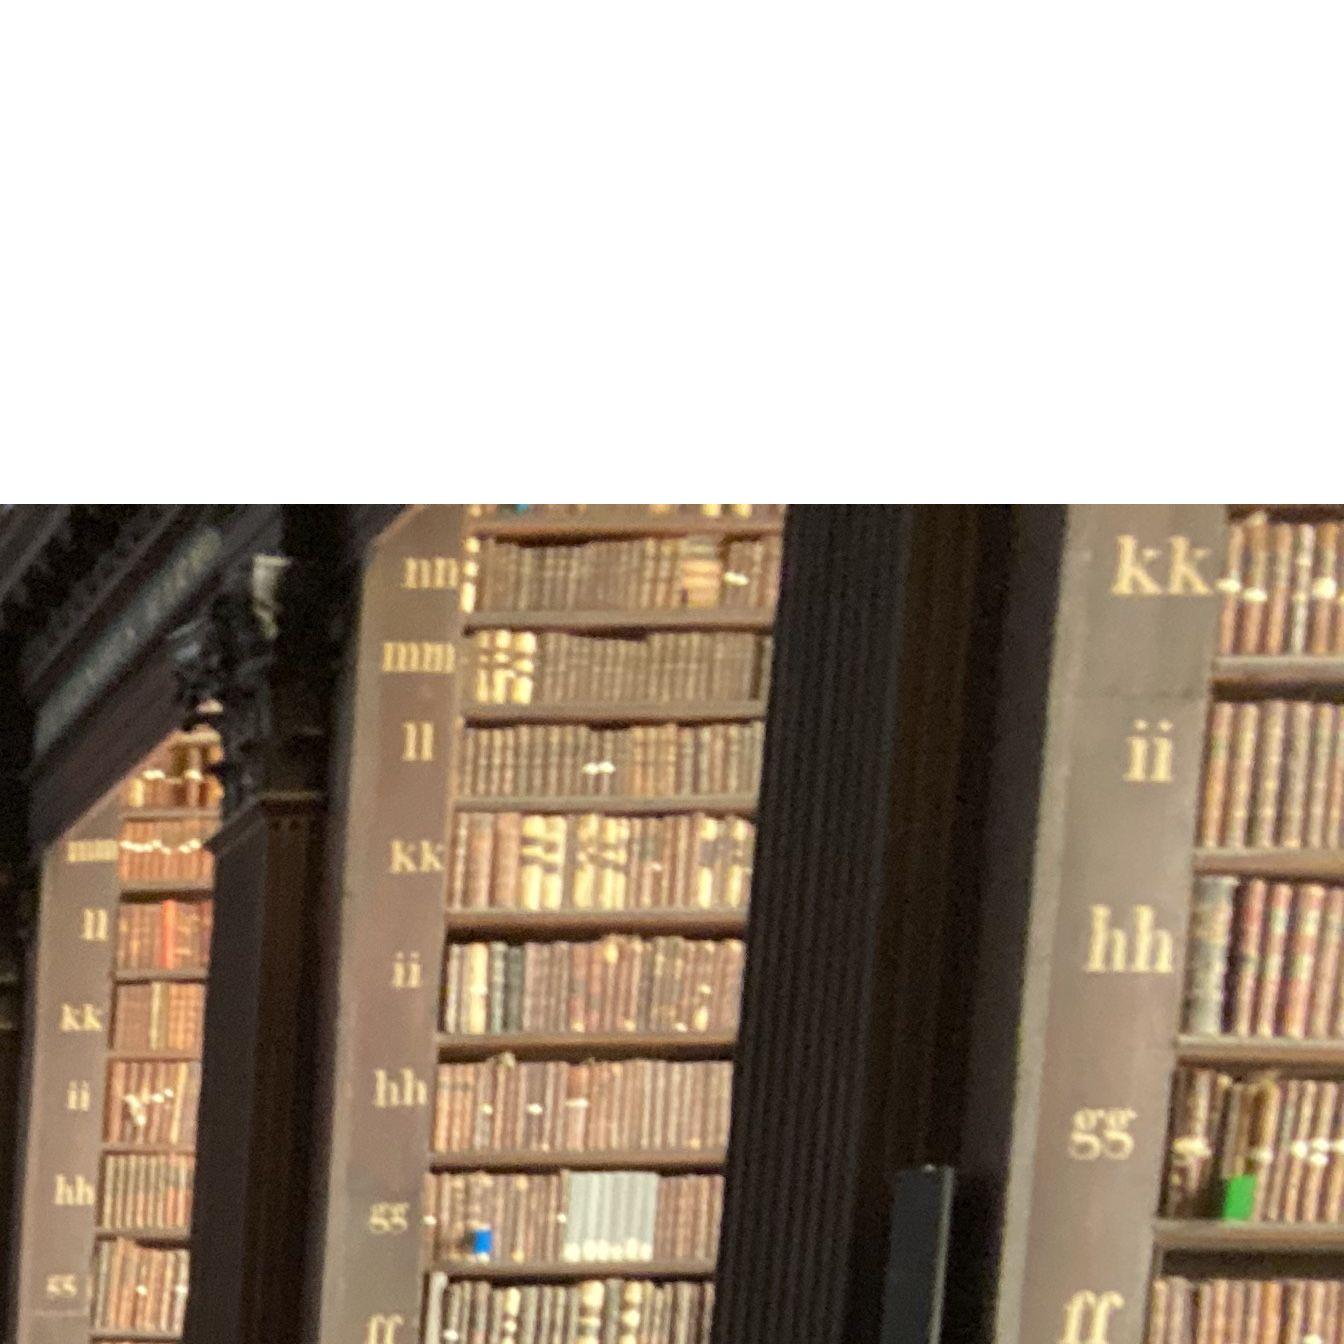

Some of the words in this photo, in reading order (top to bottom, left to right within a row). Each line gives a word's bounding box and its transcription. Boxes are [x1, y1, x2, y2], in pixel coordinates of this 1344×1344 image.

[401, 557, 459, 589] nn
[1110, 534, 1211, 595] kk
[382, 640, 457, 674] mm
[401, 719, 434, 762] ll
[1121, 717, 1176, 785] ii
[388, 838, 446, 875] kk
[81, 908, 109, 942] ll
[1083, 903, 1175, 975] hh
[392, 950, 423, 988] ii
[59, 1002, 103, 1032] kk
[66, 1079, 91, 1112] ii
[372, 1065, 428, 1108] hh
[1066, 1104, 1139, 1162] gg
[54, 1173, 96, 1206] hh
[368, 1201, 411, 1233] gg
